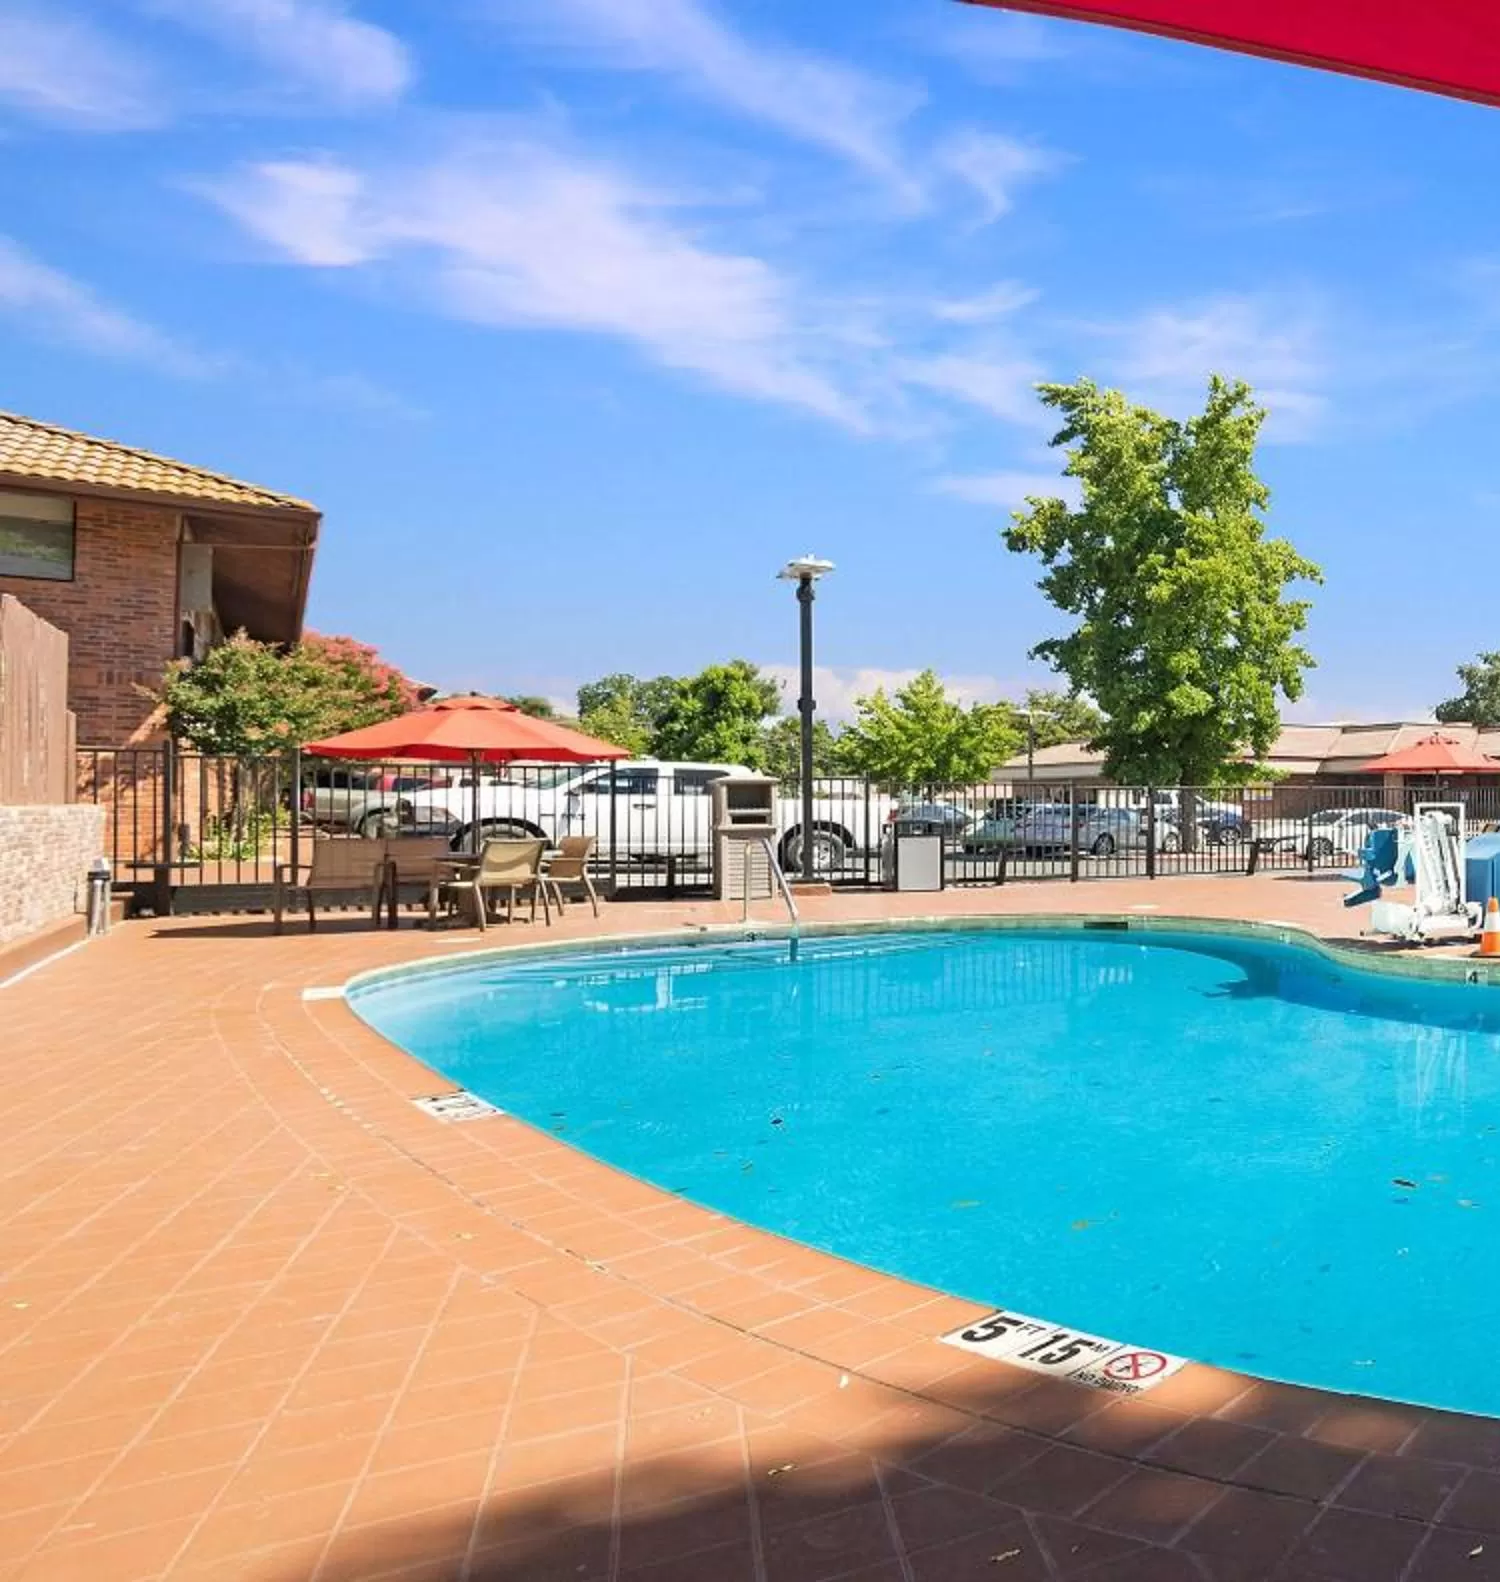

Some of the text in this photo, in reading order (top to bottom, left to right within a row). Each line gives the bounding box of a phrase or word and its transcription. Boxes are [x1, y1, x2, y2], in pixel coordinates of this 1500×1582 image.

[1468, 971, 1478, 984] 4
[961, 1316, 1025, 1342] 5
[1016, 1323, 1047, 1335] FT
[1017, 1333, 1096, 1365] 1.5
